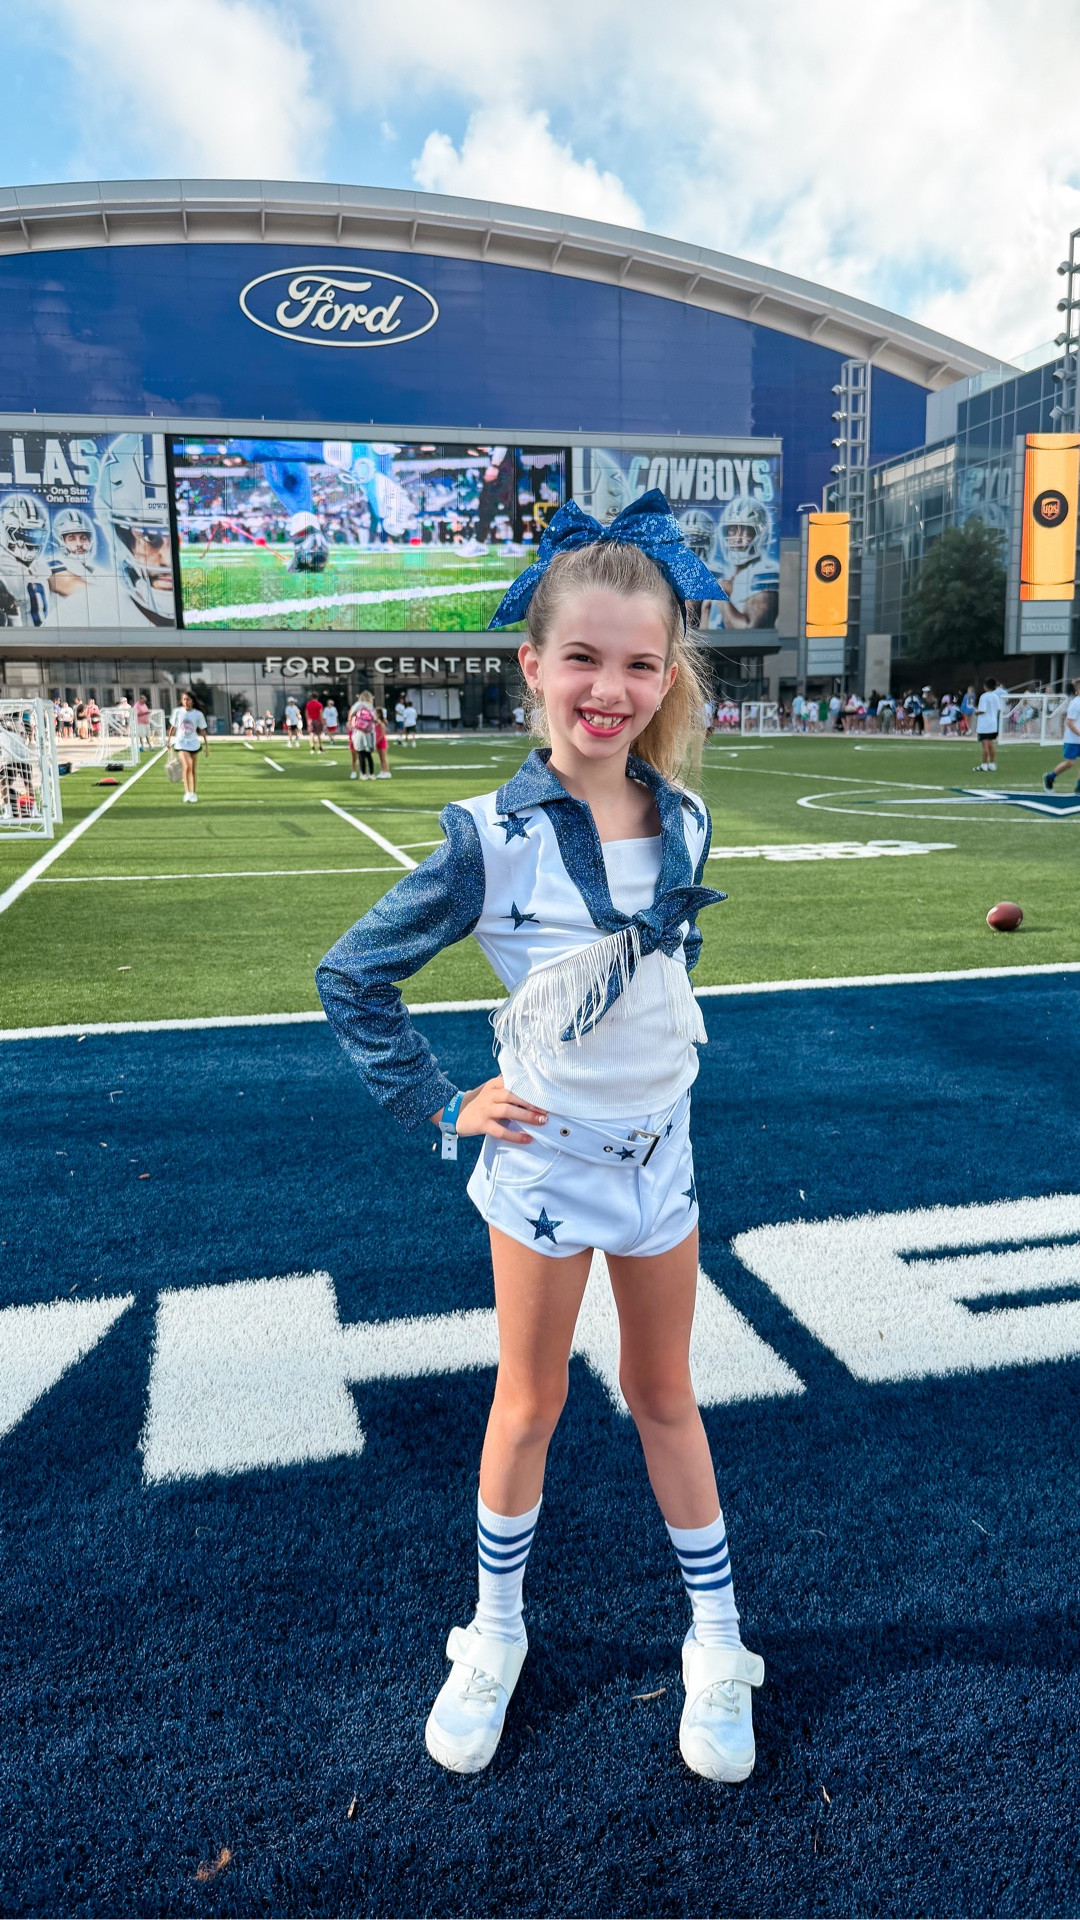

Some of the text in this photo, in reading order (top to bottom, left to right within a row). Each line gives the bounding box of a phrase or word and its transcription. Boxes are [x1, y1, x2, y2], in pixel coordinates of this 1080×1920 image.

[276, 275, 404, 334] Ford
[0, 438, 100, 486] LAS
[50, 486, 90, 496] One Star.
[627, 455, 775, 502] COWBOYS
[46, 494, 91, 503] One Team.
[265, 656, 502, 674] FORD CENTER
